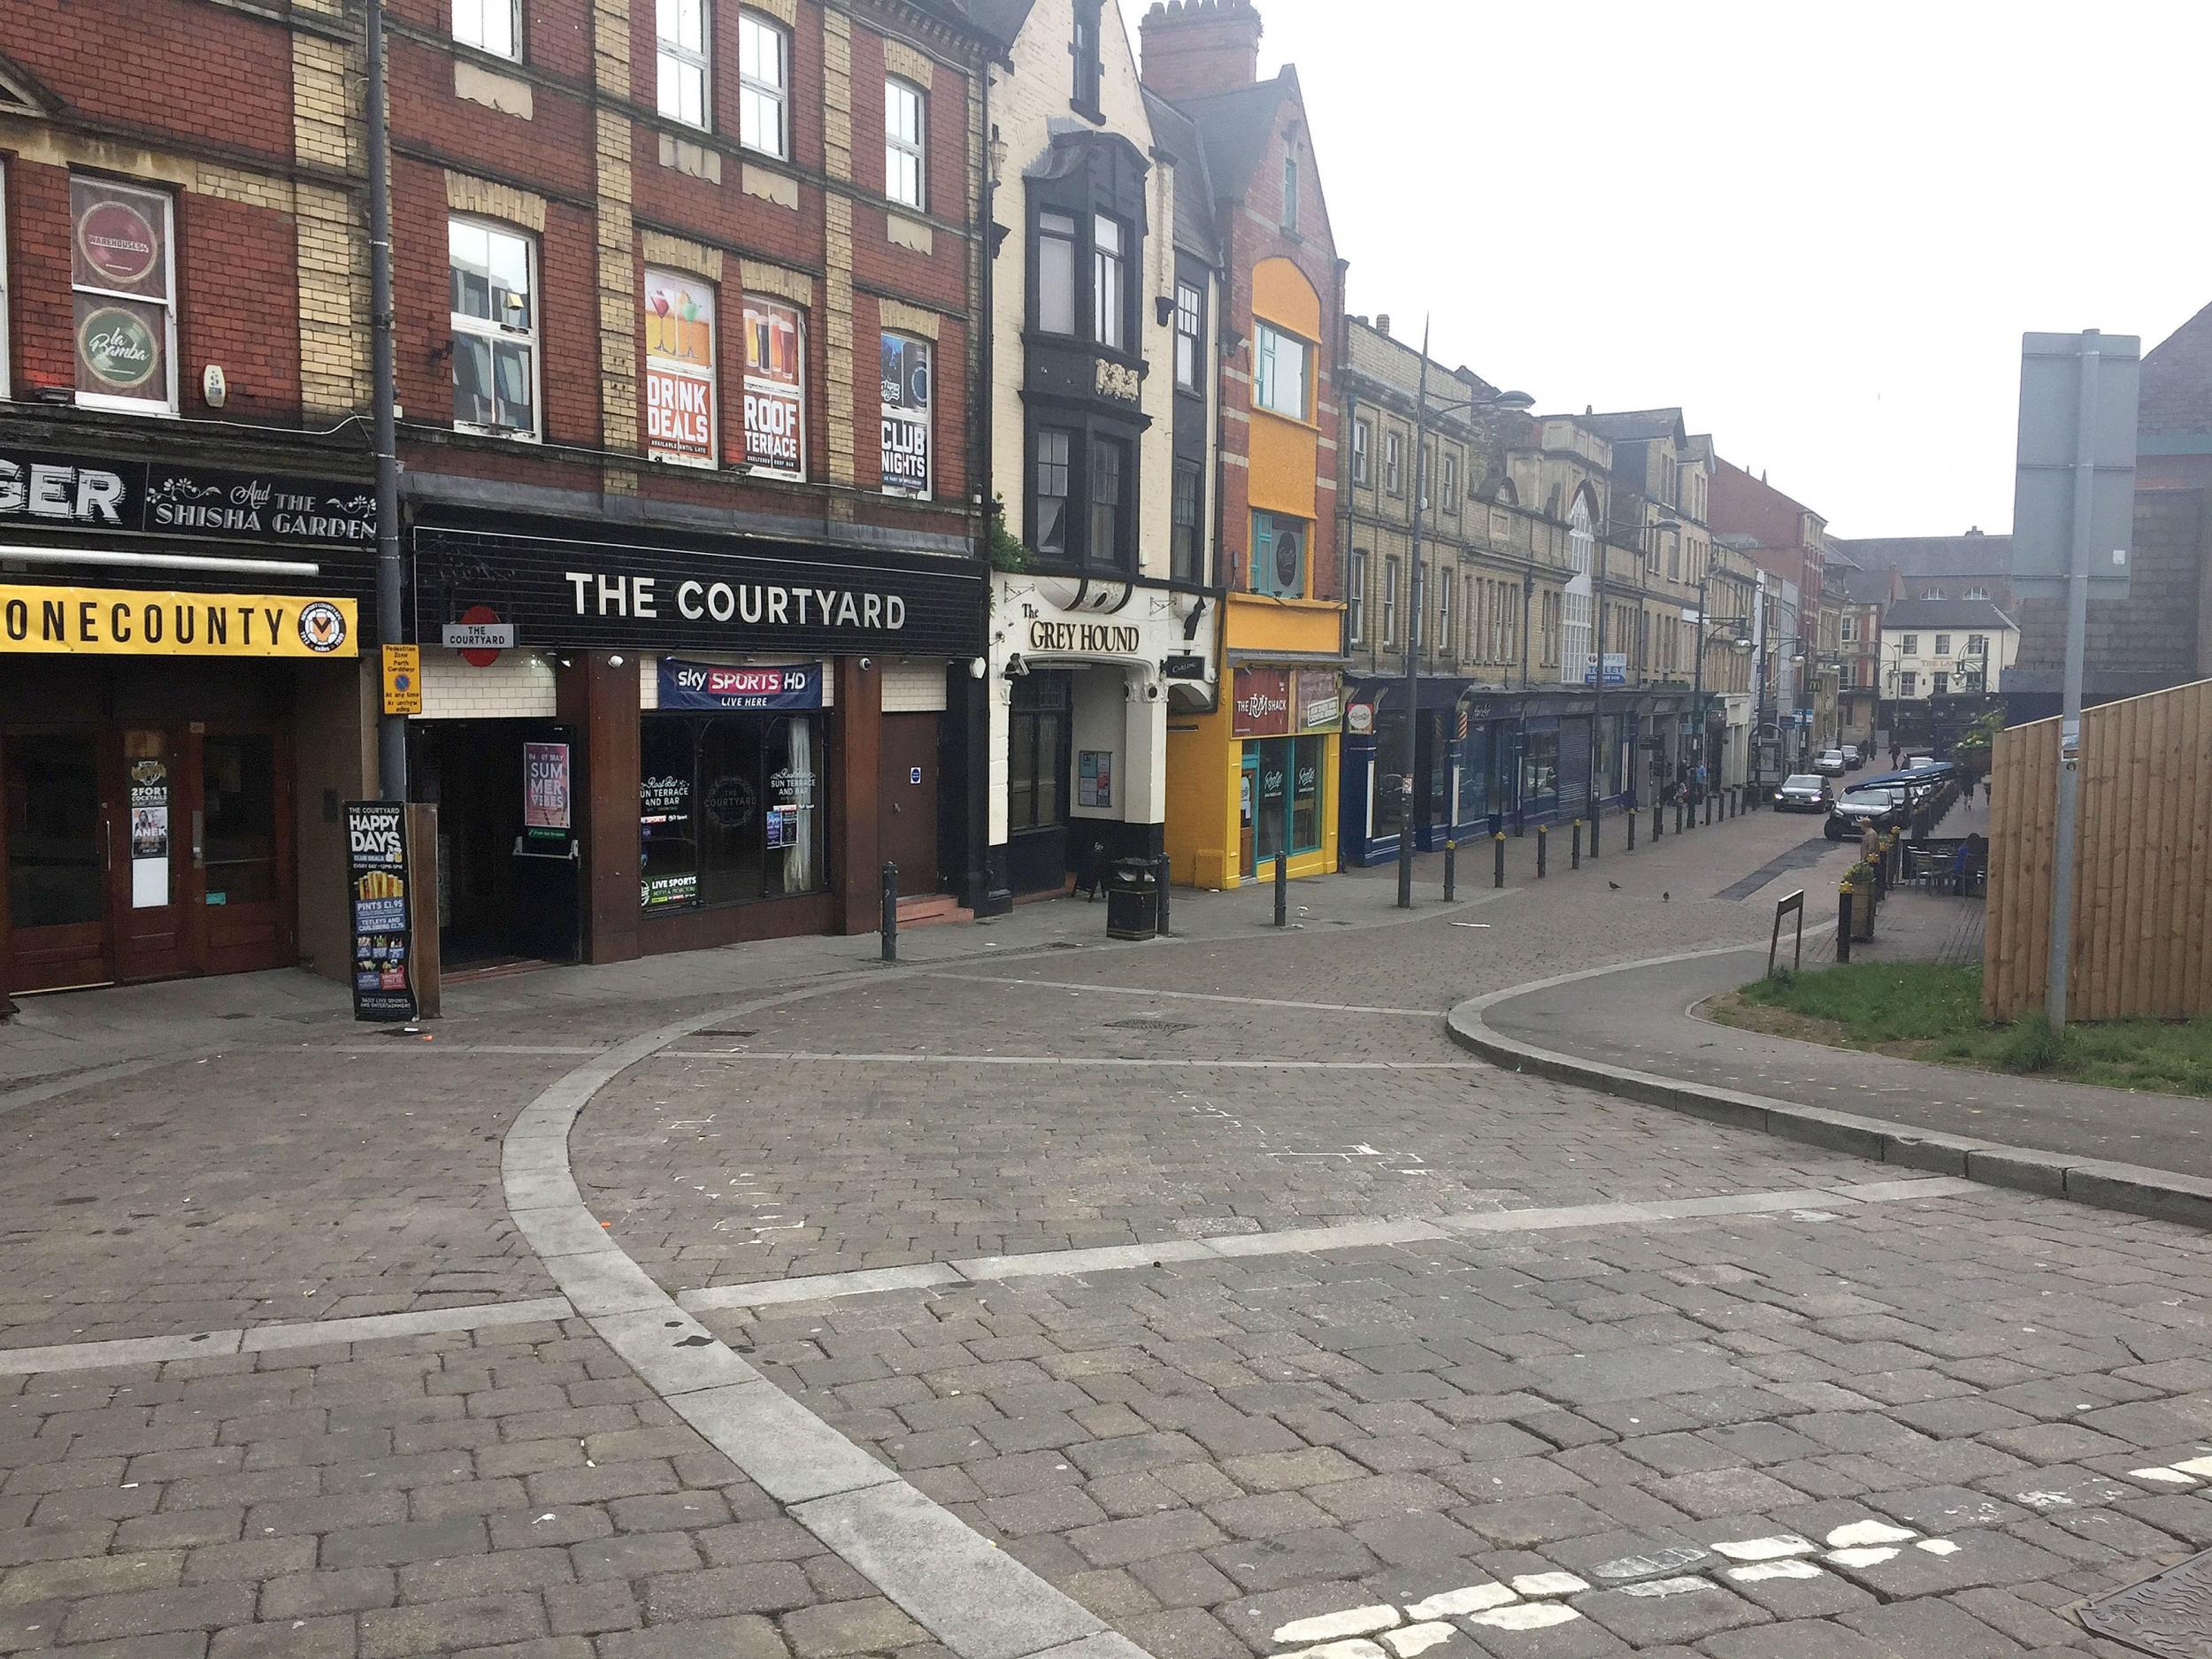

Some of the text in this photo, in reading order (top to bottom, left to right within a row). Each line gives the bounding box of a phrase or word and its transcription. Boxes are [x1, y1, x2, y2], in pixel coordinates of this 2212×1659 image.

[110, 326, 127, 346] la
[89, 333, 150, 361] Bamba
[648, 374, 707, 415] DRINK
[648, 406, 708, 443] DEALS
[744, 395, 796, 436] ROOF
[881, 420, 925, 456] CLUB
[881, 449, 926, 478] NIGHTS
[230, 480, 317, 512] And THE
[155, 503, 377, 540] SHISHA GARDEN
[565, 572, 906, 630] THE COURTYARD
[1022, 603, 1039, 618] The
[5, 599, 283, 645] ONECOUNTY
[468, 626, 486, 634] THE
[449, 635, 505, 644] COURTYARD
[1030, 620, 1140, 652] GREY HOUND
[678, 668, 806, 692] sky SPORTS HD
[721, 697, 767, 707] LIVE HERE
[1237, 700, 1249, 712] THE
[1268, 700, 1286, 711] SHACK
[531, 762, 563, 779] SUM
[531, 779, 562, 795] MER
[787, 779, 816, 787] TERRACE
[531, 795, 564, 808] VIBES
[640, 787, 688, 798] UN TERRACE
[703, 796, 757, 807] COURTYARD
[349, 815, 399, 831] HAPPY
[350, 831, 401, 852] DAYS
[651, 876, 697, 889] LIVE SPORTS
[357, 900, 403, 911] PINTS £1.95
